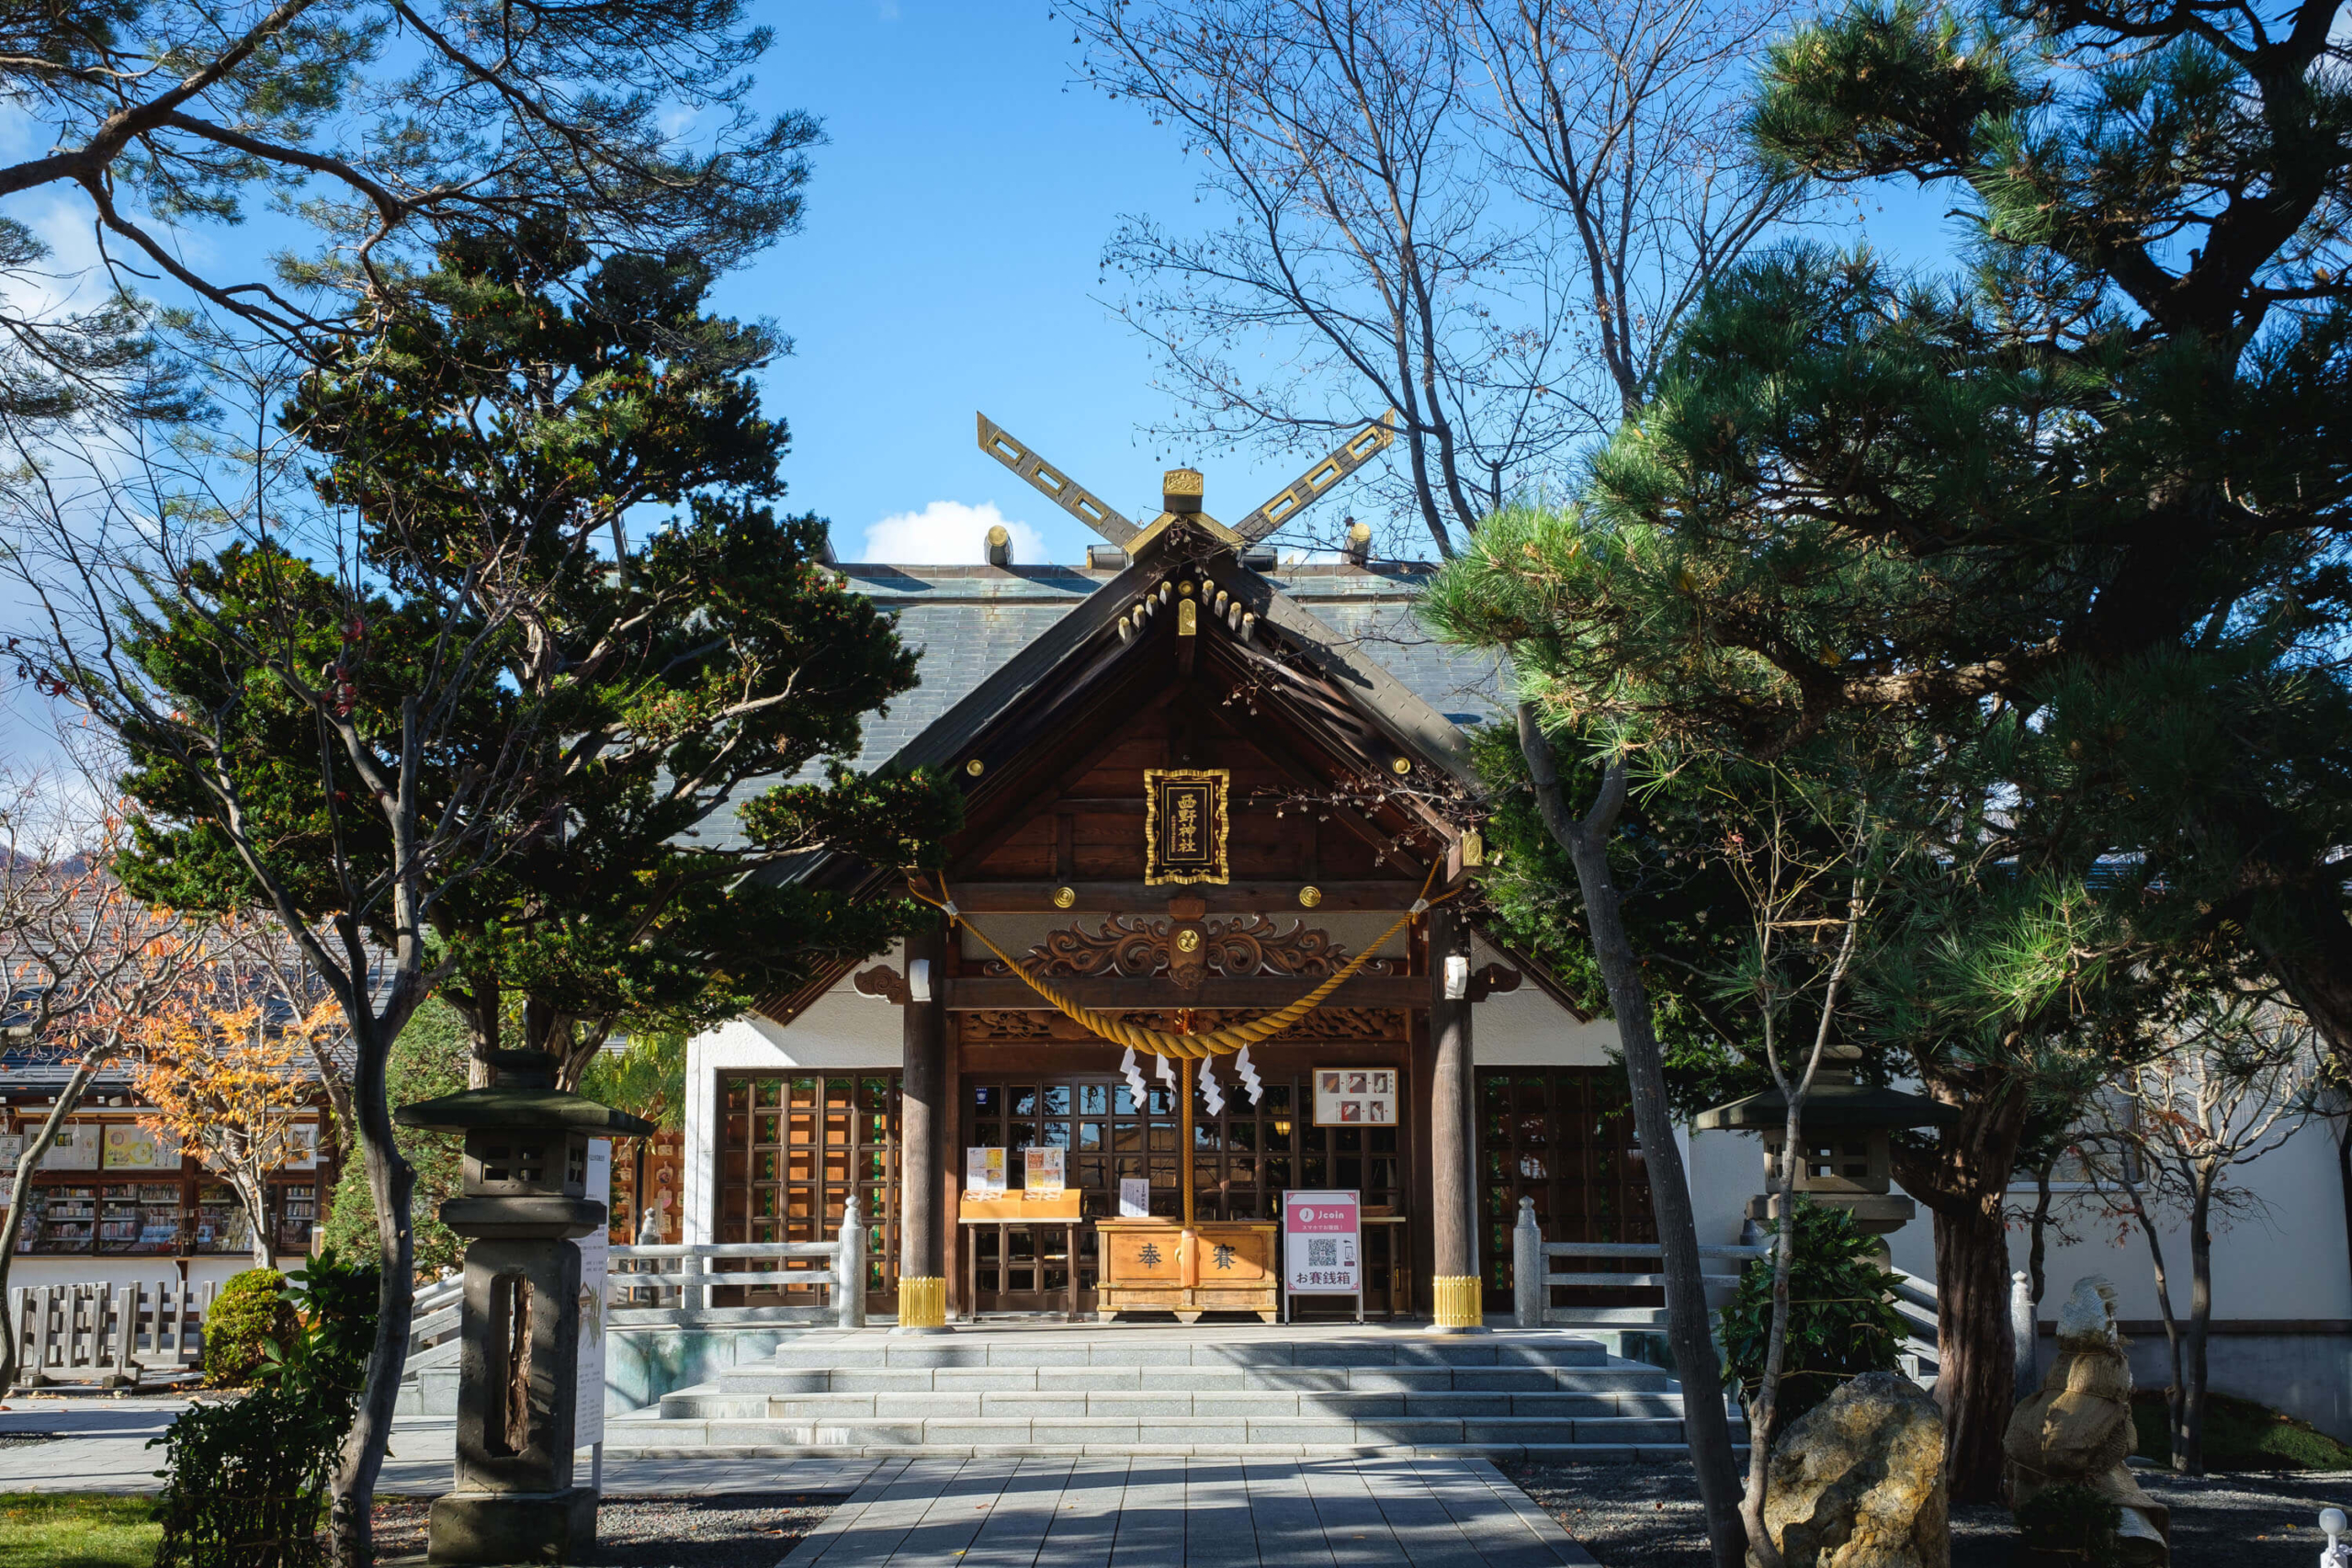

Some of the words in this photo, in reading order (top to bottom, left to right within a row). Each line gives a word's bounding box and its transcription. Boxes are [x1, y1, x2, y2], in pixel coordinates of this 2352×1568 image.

[1177, 794, 1197, 852] 西野神社
[1317, 1210, 1345, 1220] Jcoin
[1138, 1242, 1162, 1269] 奉
[1212, 1243, 1237, 1269] 賽
[1296, 1271, 1351, 1285] お賽銭箱
